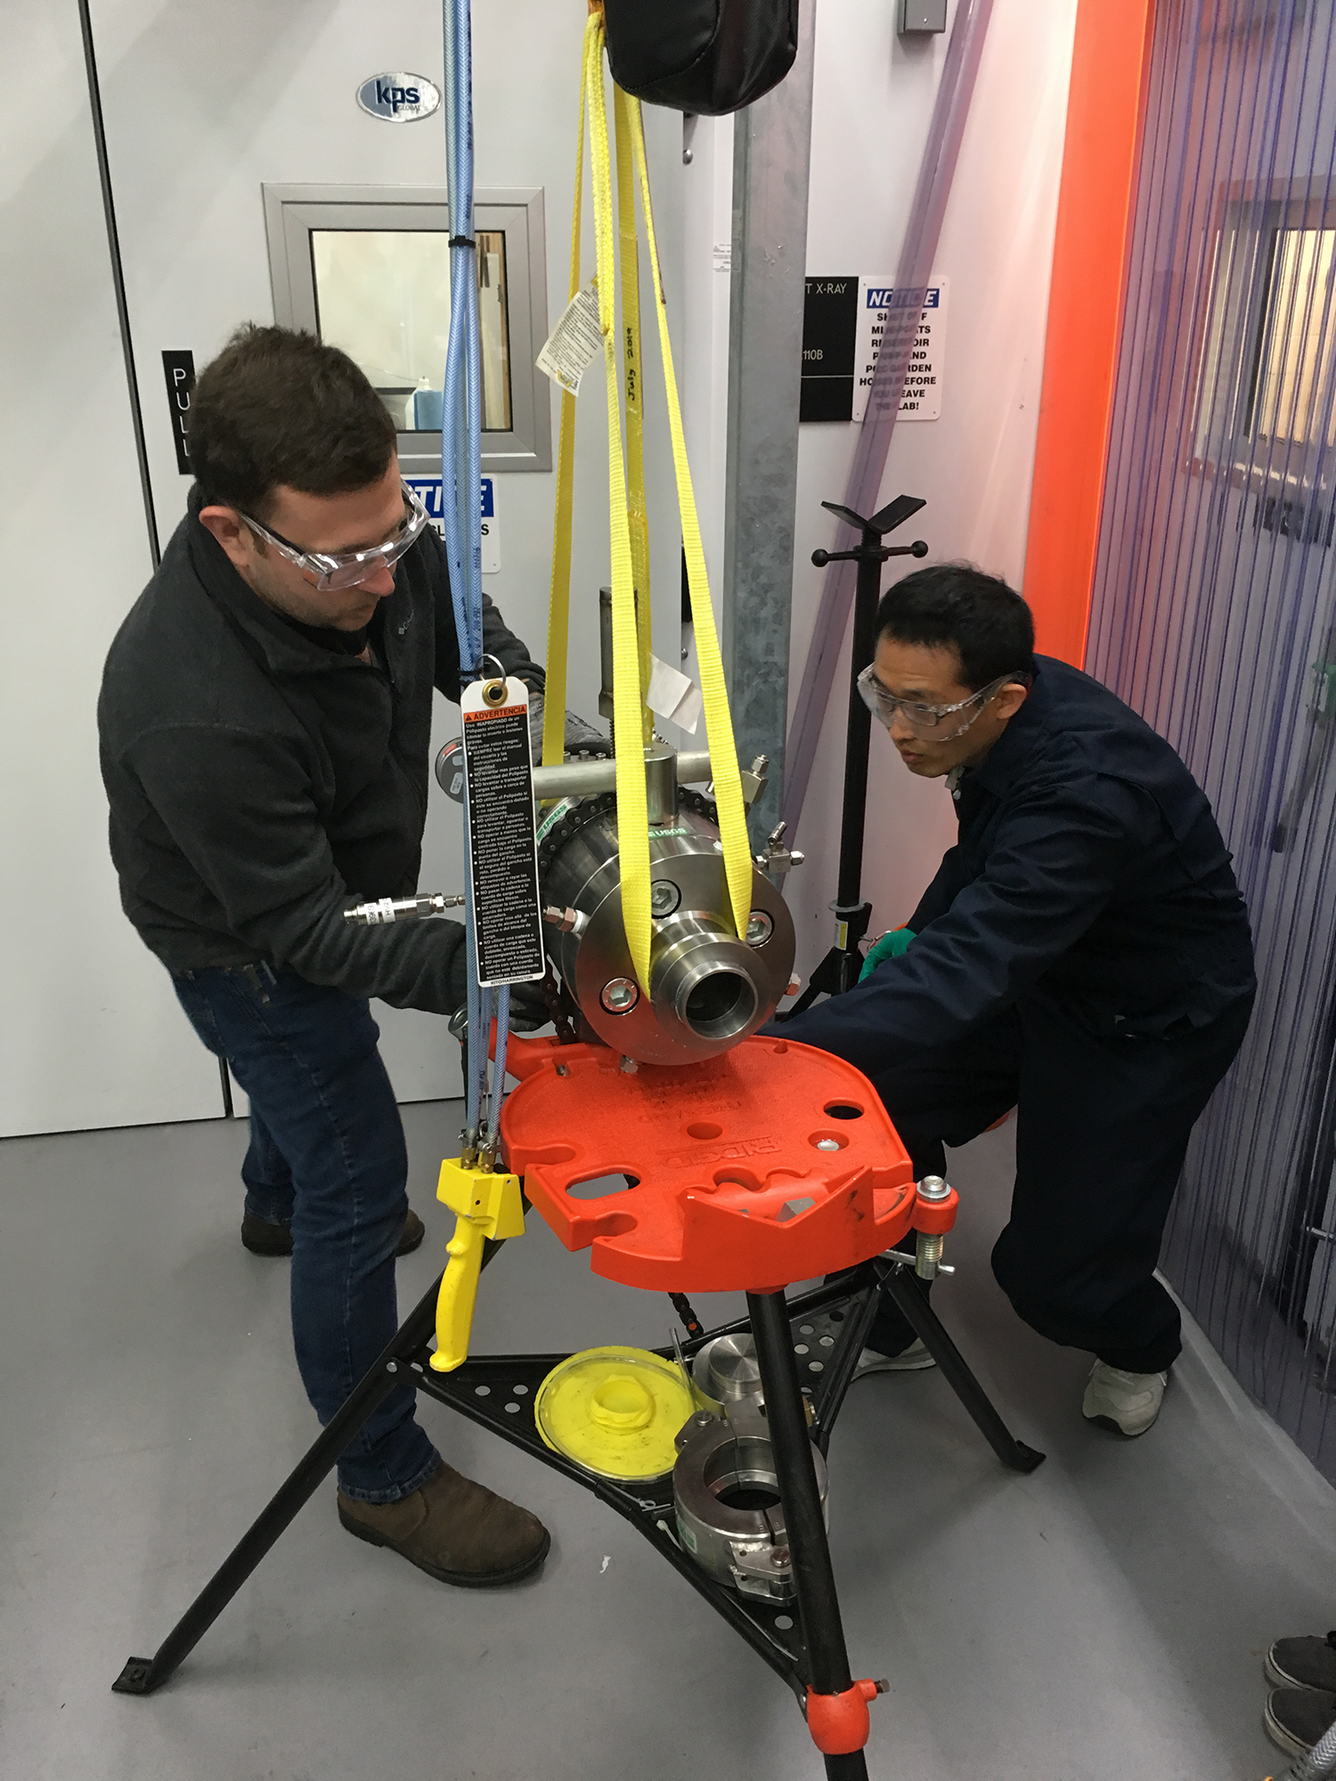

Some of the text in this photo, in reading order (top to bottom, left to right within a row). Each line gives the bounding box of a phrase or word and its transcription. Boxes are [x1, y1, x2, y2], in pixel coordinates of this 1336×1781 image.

[376, 80, 420, 112] kps
[816, 283, 847, 294] X-RAY
[627, 369, 636, 401] July
[473, 706, 525, 719] ADVERTENCIA
[543, 804, 568, 830] USGS
[655, 827, 687, 836] USGS
